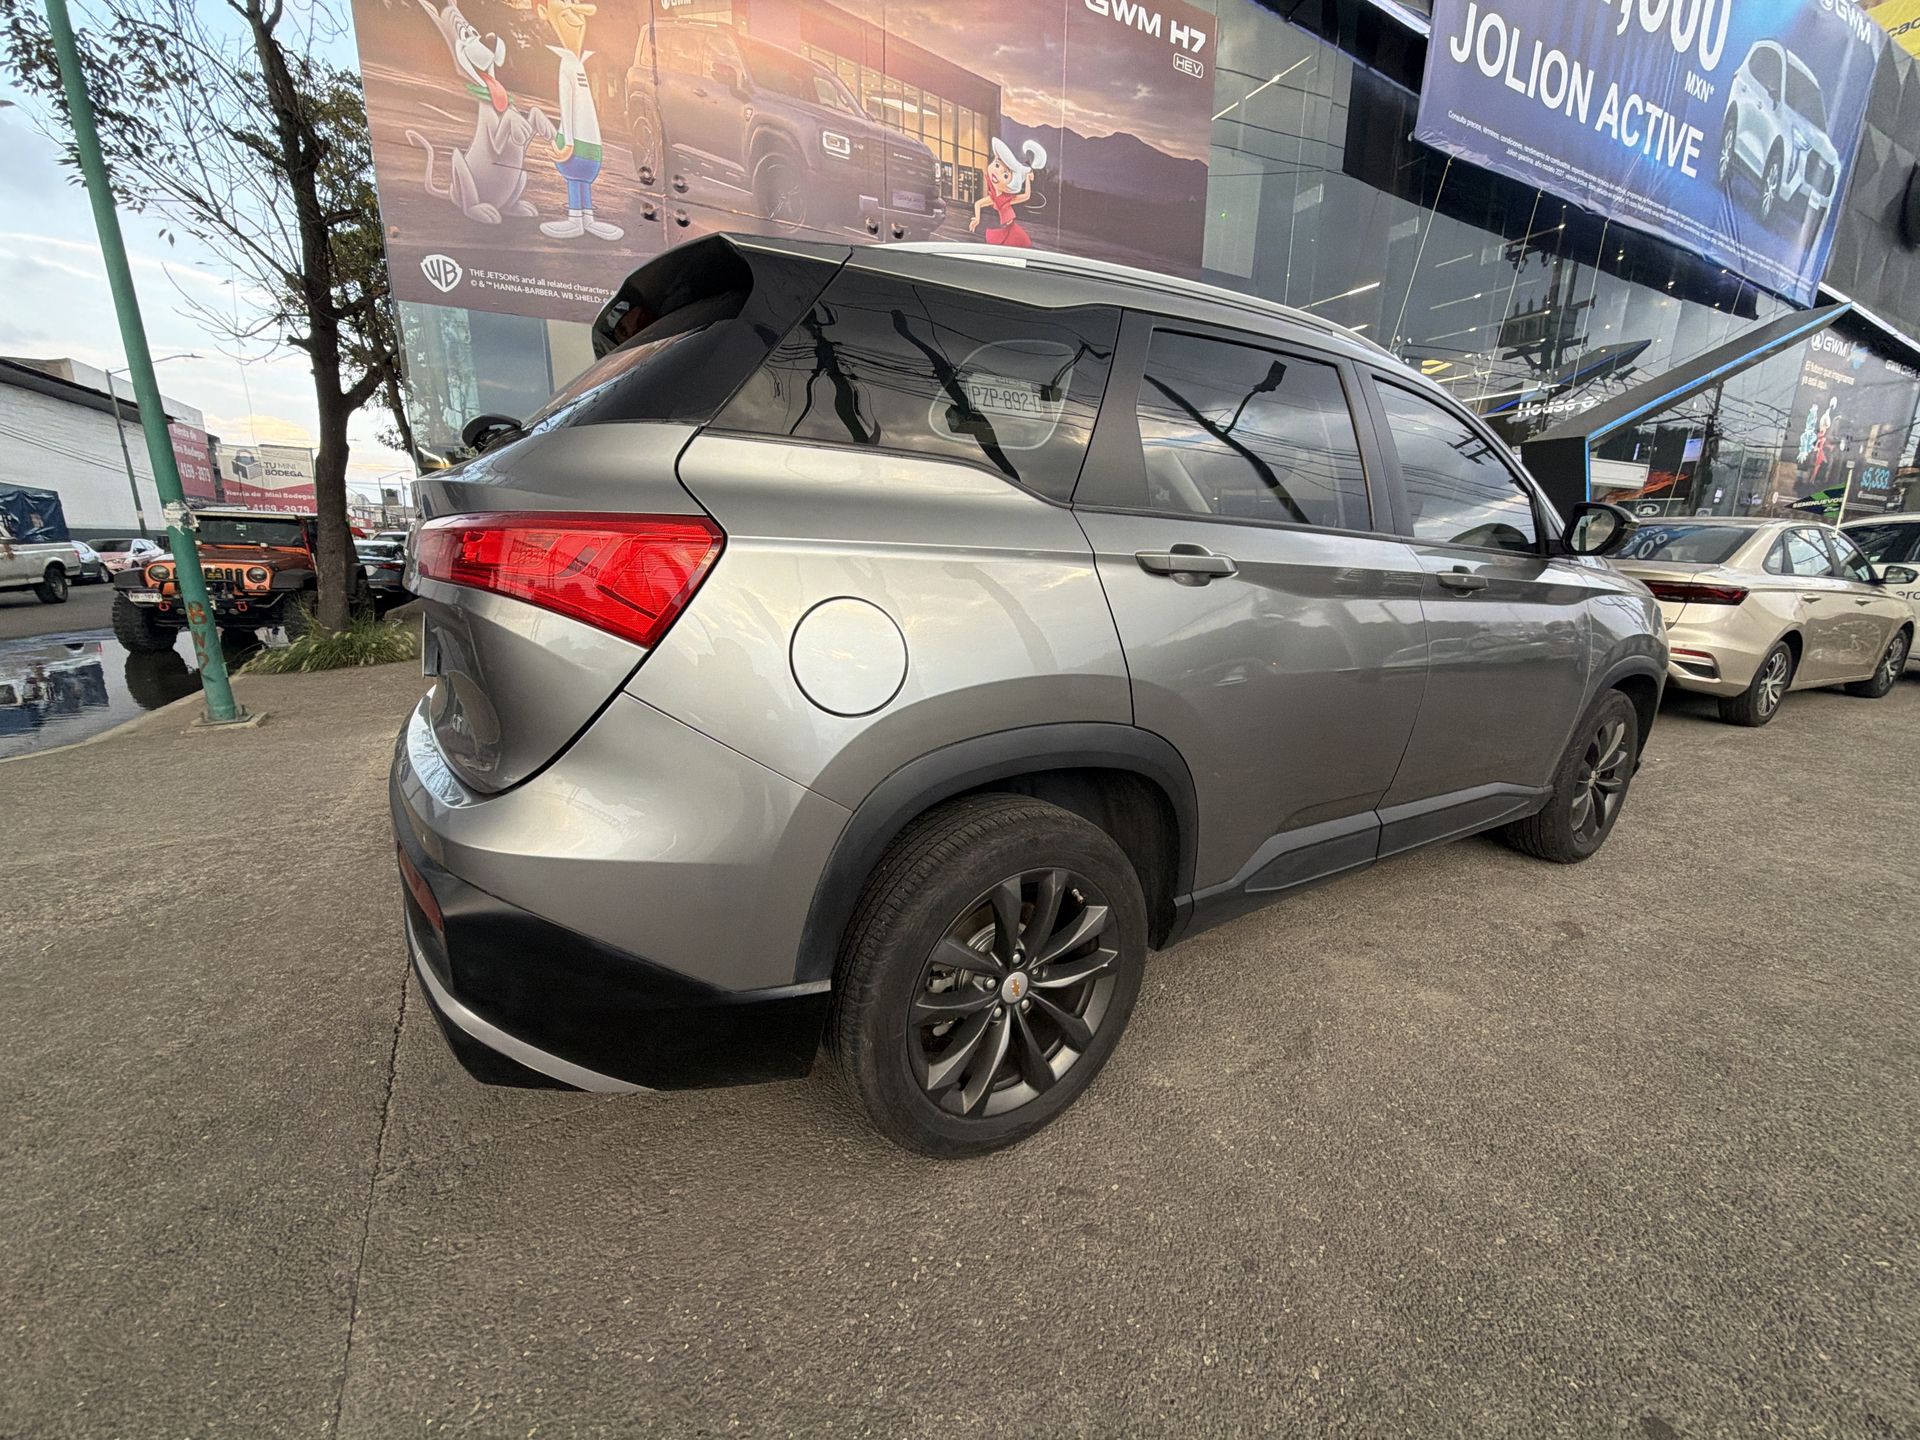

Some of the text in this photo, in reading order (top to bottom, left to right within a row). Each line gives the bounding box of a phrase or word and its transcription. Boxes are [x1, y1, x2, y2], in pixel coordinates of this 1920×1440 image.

[1836, 0, 1871, 44] GWM
[1170, 20, 1206, 53] H7
[1175, 56, 1201, 75] HEV
[1450, 2, 1704, 178] JOLION ACTIVE
[423, 257, 459, 289] WB
[469, 268, 485, 278] THE
[486, 271, 520, 283] JETSONS
[521, 276, 536, 285] and
[537, 278, 546, 286] all
[547, 280, 573, 290] related
[573, 283, 610, 296] characters
[562, 291, 574, 301] WB
[575, 293, 602, 304] SHIELD:
[1823, 336, 1849, 357] GWM
[1517, 398, 1576, 418] House
[264, 461, 276, 469] TU
